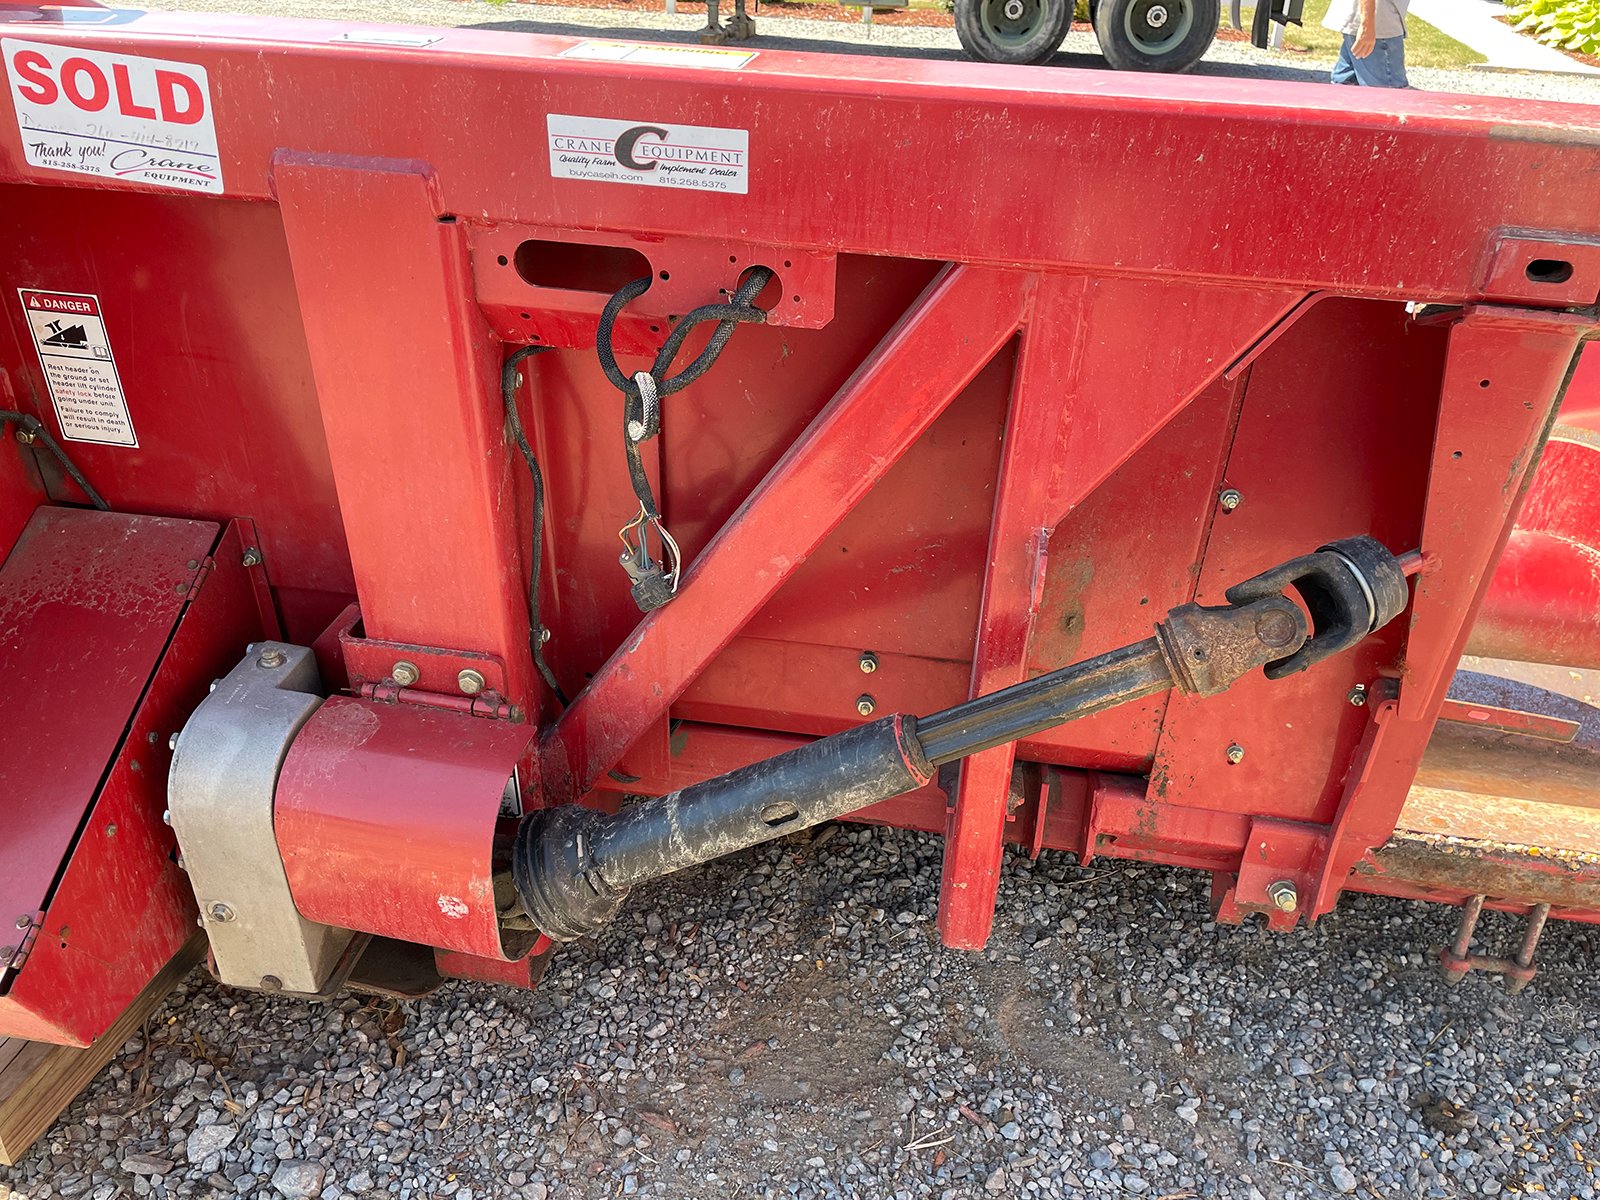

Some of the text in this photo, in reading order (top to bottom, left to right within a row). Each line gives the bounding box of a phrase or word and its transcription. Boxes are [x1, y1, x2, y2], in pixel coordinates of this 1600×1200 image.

[13, 50, 205, 125] SOLD
[554, 137, 612, 153] CRANE
[614, 126, 669, 171] C
[29, 141, 107, 164] Thank you!
[642, 145, 742, 164] EQUIPMENT
[42, 159, 101, 173] 815-258-5375
[110, 149, 214, 172] Crane
[559, 154, 737, 177] Quality Farm Implement Dealer
[144, 171, 211, 187] EQUIPMENT
[569, 169, 727, 189] buycaseih.com 815.258.5375
[43, 299, 91, 312] DANGER
[65, 366, 88, 374] header
[63, 373, 87, 382] ground
[53, 380, 75, 388] header
[89, 383, 116, 392] cylinder
[55, 388, 116, 399] safety lock before
[58, 397, 76, 405] going
[61, 406, 84, 414] Failure
[95, 410, 119, 418] comply
[101, 425, 124, 433] injury.
[107, 418, 126, 426] death
